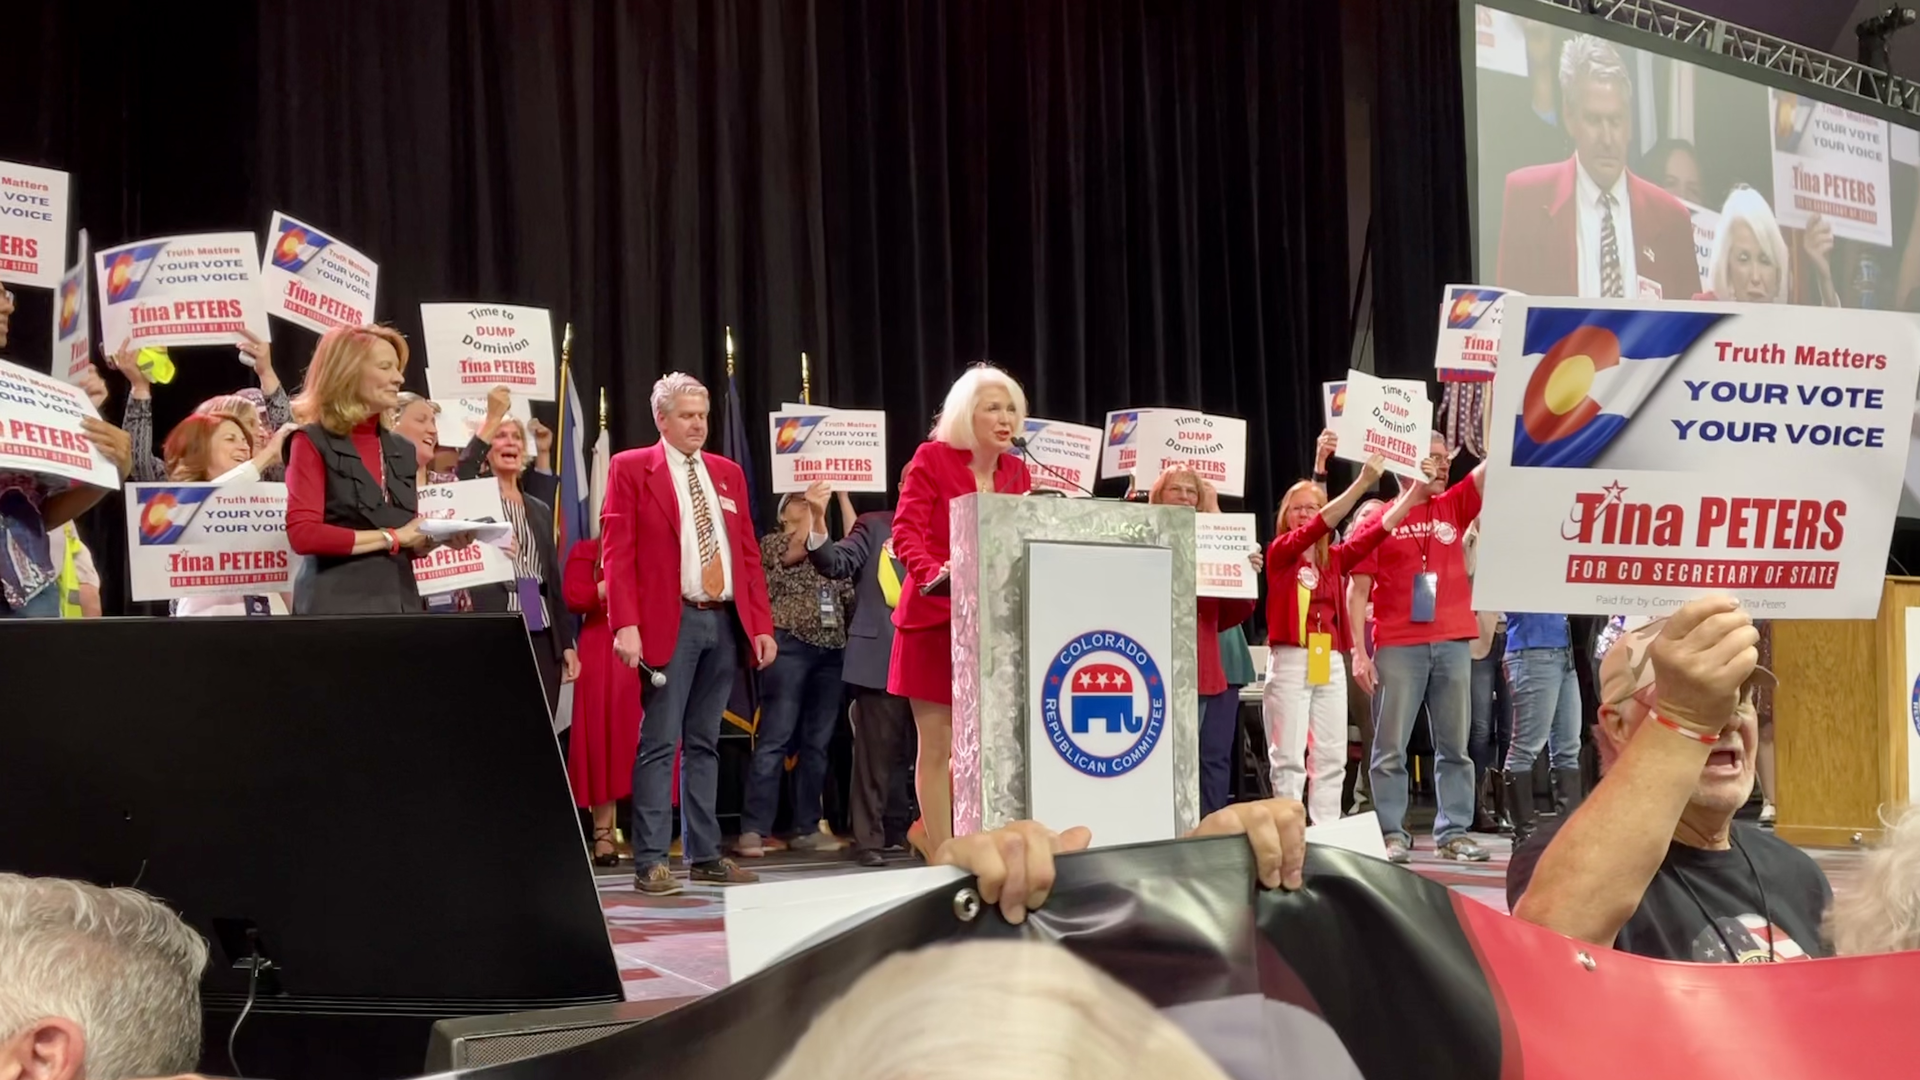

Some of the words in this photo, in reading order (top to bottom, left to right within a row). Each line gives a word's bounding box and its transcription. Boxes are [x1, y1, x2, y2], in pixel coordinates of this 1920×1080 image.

[1814, 119, 1847, 137] YOUR
[1849, 128, 1880, 145] VOTE
[1812, 135, 1845, 153] YOUR
[1847, 144, 1883, 163] VOICE
[1, 177, 48, 191] Matters
[1791, 166, 1821, 195] Tina
[1823, 172, 1876, 207] PETERS
[4, 191, 50, 206] VOTE
[0, 206, 52, 221] VOICE
[166, 249, 194, 258] Truth
[197, 246, 240, 256] Matters
[157, 261, 199, 271] YOUR
[201, 259, 243, 268] VOTE
[320, 256, 347, 275] YOUR
[348, 270, 370, 289] VOTE
[156, 275, 198, 285] YOUR
[201, 273, 249, 282] VOICE
[316, 267, 343, 286] YOUR
[345, 281, 371, 300] VOICE
[288, 280, 317, 306] Tina
[319, 294, 363, 325] PETERS
[129, 304, 170, 325] Tina
[173, 299, 243, 320] PETERS
[467, 308, 499, 320] Time
[502, 309, 515, 321] to
[476, 326, 516, 337] DUMP
[462, 334, 530, 354] Dominion
[1464, 335, 1494, 351] Tina
[1714, 341, 1785, 365] Truth
[1794, 345, 1888, 370] Matters
[459, 358, 492, 373] Tina
[494, 359, 536, 375] PETERS
[0, 370, 27, 383] ruth
[0, 380, 36, 395] OUR
[37, 390, 83, 410] VOTE
[1382, 384, 1402, 397] Time
[1403, 391, 1412, 403] to
[1683, 380, 1789, 404] YOUR
[1796, 384, 1885, 410] VOTE
[0, 391, 37, 407] OUR
[39, 400, 85, 419] VOIC
[1383, 401, 1409, 419] DUMP
[1174, 416, 1201, 427] Time
[1203, 417, 1214, 428] to
[1372, 406, 1417, 434] Dominion
[9, 419, 90, 454] PETERS
[1178, 431, 1213, 441] DUMP
[1670, 420, 1778, 443] YOUR
[1784, 423, 1885, 448] VOICE
[1036, 445, 1062, 454] YOUR
[1062, 449, 1091, 460] VOICE
[1039, 437, 1065, 446] YOUR
[1066, 440, 1091, 451] VOTE
[1165, 437, 1225, 455] Dominion
[1365, 429, 1386, 447] Tina
[1387, 436, 1417, 459] PETERS
[793, 458, 822, 472] Tina
[825, 458, 872, 472] PETERS
[1189, 459, 1226, 474] PETERS
[215, 496, 246, 505] Truth
[249, 495, 288, 504] Matter
[417, 487, 437, 500] me
[440, 487, 454, 499] to
[205, 510, 250, 519] YOUR
[253, 509, 286, 518] VOT
[1572, 491, 1685, 547] Tina
[1695, 496, 1848, 551] PETERS
[203, 525, 248, 533] YOUR
[252, 524, 288, 532] VOIC
[168, 552, 214, 573] Tina
[219, 550, 288, 571] PETERS
[436, 545, 482, 567] PETERS
[1199, 562, 1242, 577] ETERS
[1570, 560, 1607, 580] FOR
[1618, 561, 1643, 581] CO
[1653, 562, 1759, 584] SECRETARY
[1765, 564, 1784, 584] OF
[1790, 565, 1836, 585] STATE
[1596, 595, 1618, 605] Paid
[1619, 596, 1634, 606] for
[1636, 596, 1649, 608] by
[1743, 599, 1760, 608] Tina
[1761, 599, 1787, 609] Peters
[1060, 633, 1148, 665] COLORADO
[1045, 698, 1107, 773] REPUBLICAN
[1112, 698, 1163, 771] COMMITTEE
